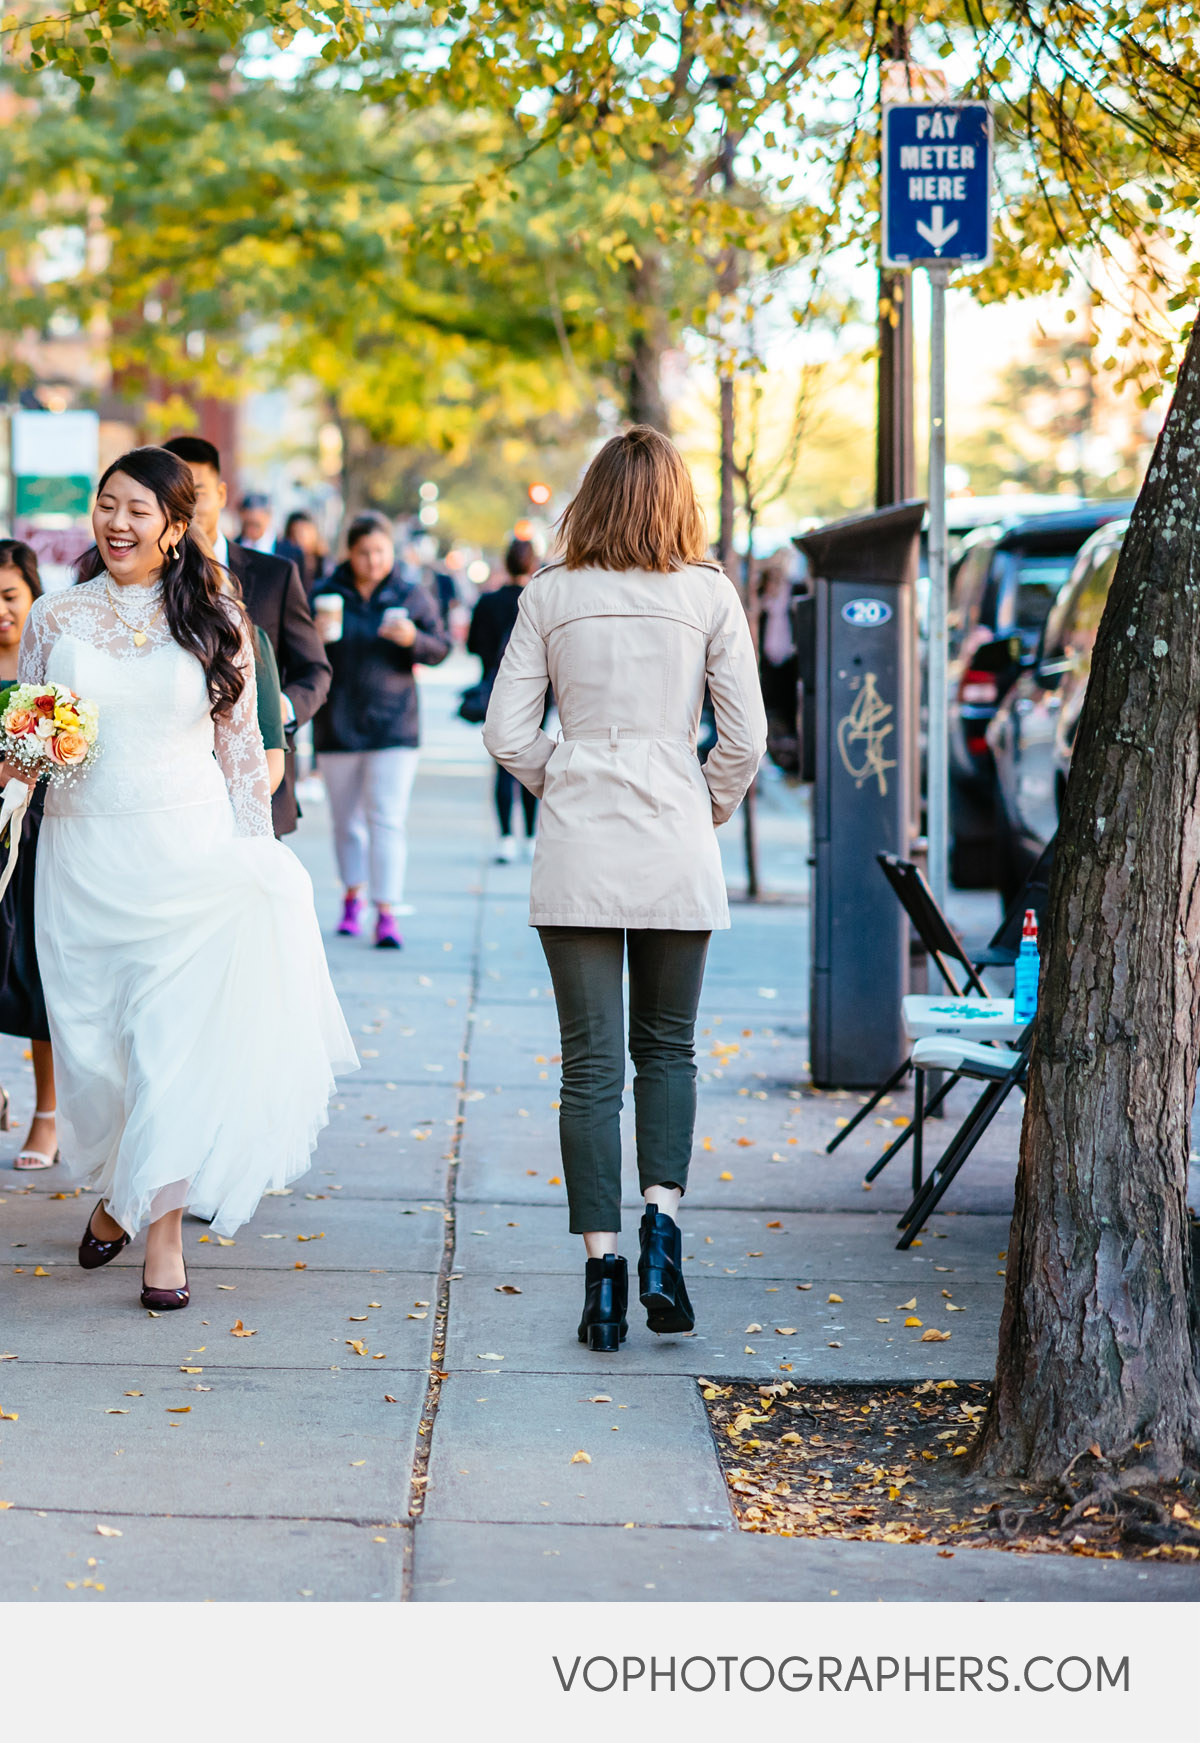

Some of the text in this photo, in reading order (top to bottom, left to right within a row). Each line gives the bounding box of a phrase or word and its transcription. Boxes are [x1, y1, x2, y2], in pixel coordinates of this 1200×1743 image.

[916, 112, 958, 139] PAY
[900, 146, 974, 169] METER
[909, 177, 966, 200] HERE
[853, 601, 881, 623] 20
